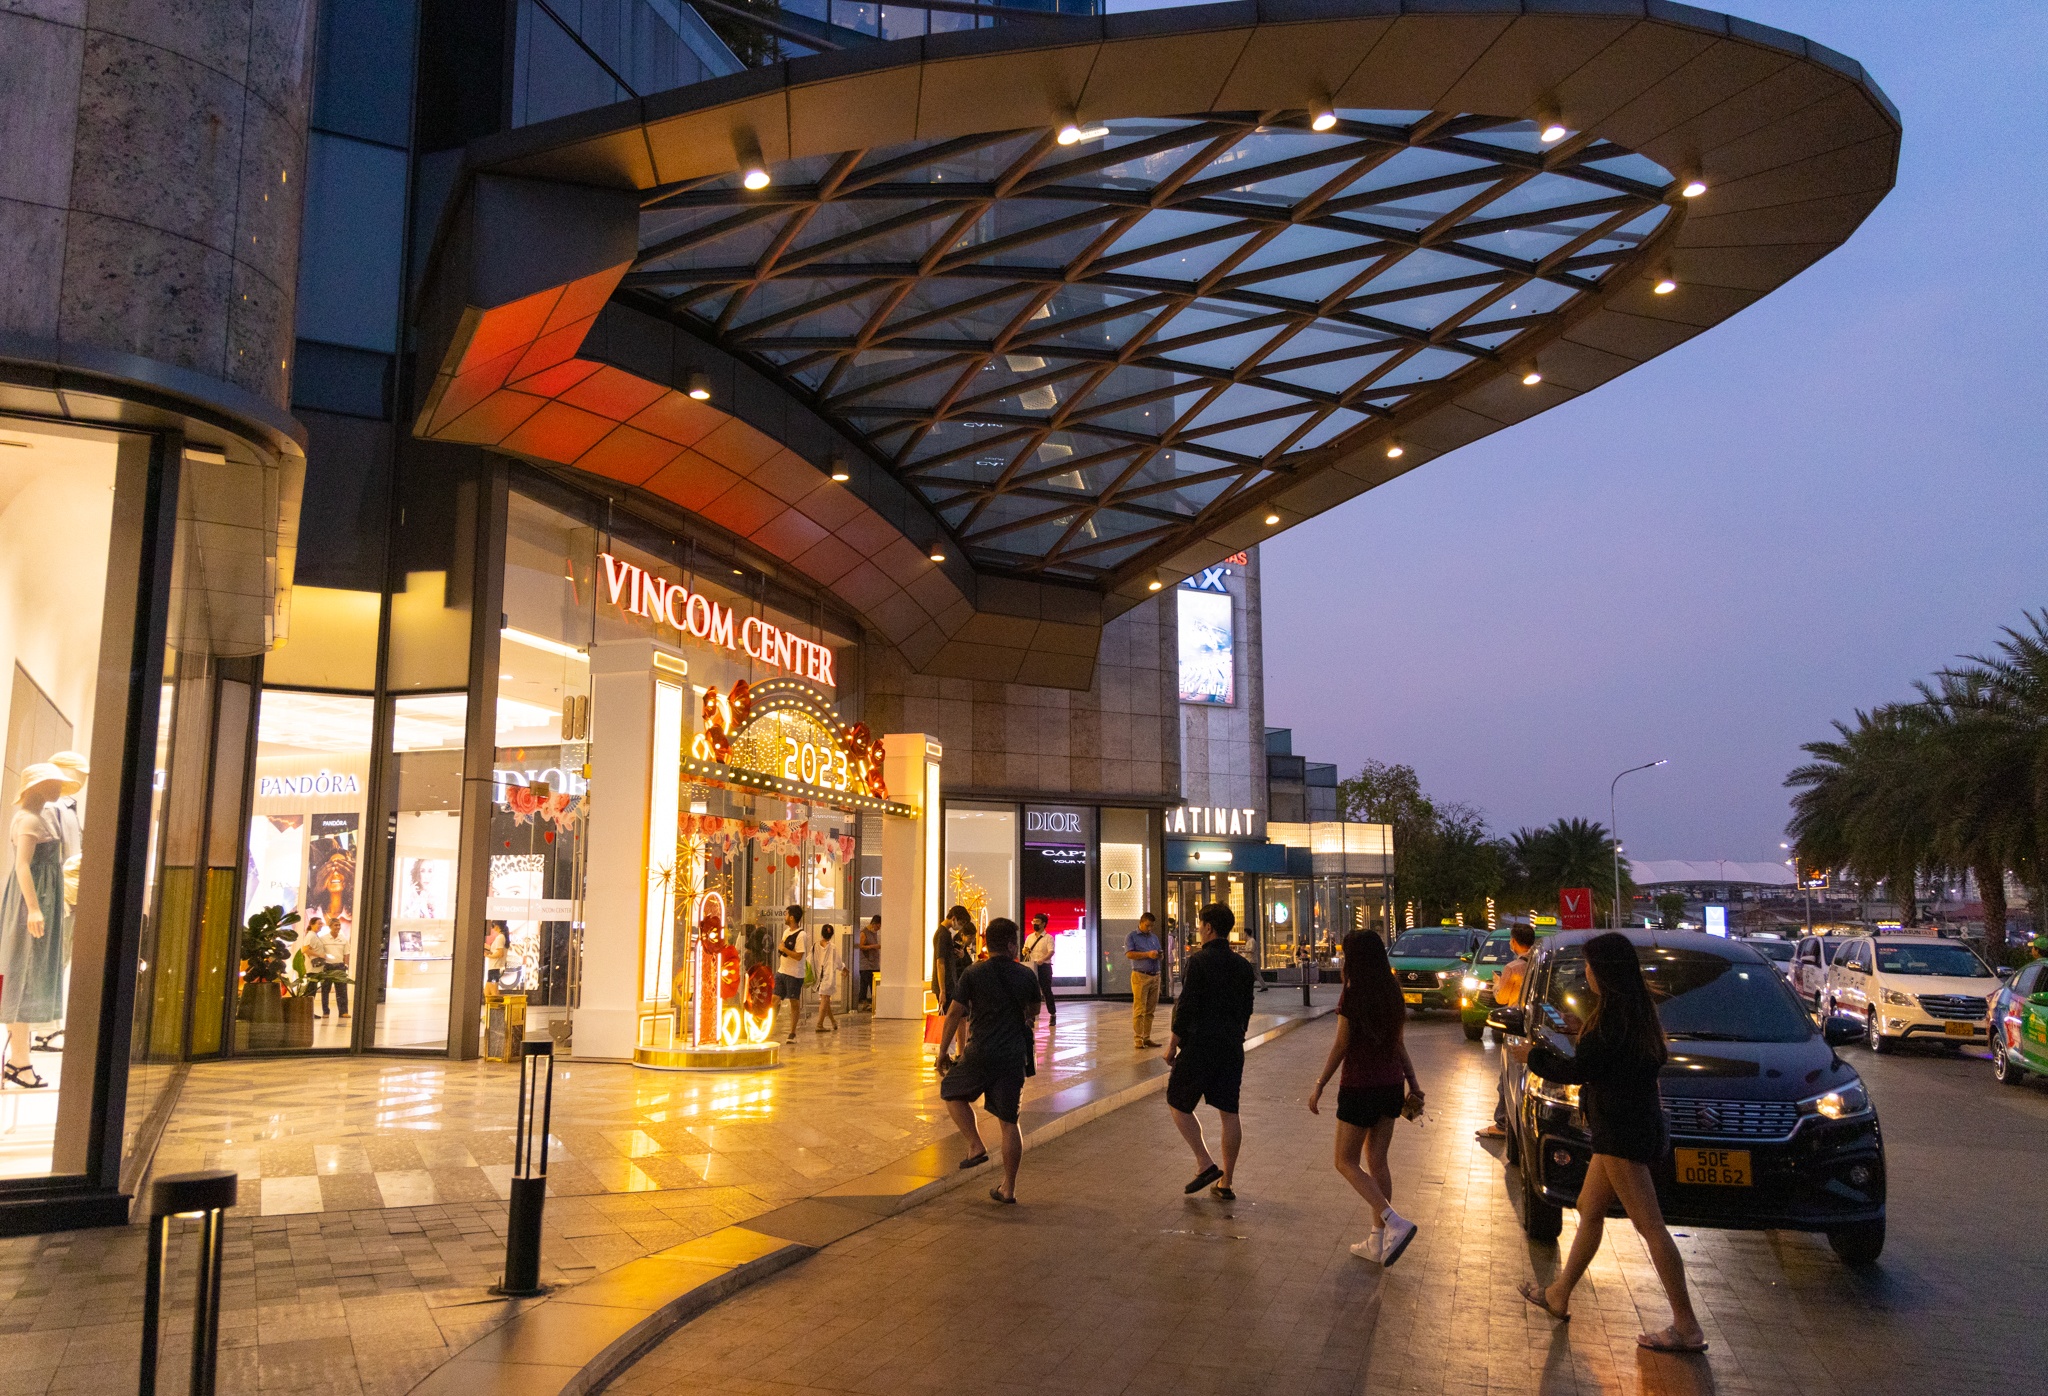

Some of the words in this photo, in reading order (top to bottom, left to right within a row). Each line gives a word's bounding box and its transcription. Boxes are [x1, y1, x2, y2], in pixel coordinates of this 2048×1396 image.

[601, 553, 736, 650] VINCOM
[742, 616, 836, 687] CENTER
[784, 736, 848, 791] 2023
[1027, 812, 1081, 832] DIOR
[1697, 1152, 1729, 1167] 50E
[1685, 1167, 1744, 1184] 008.62
